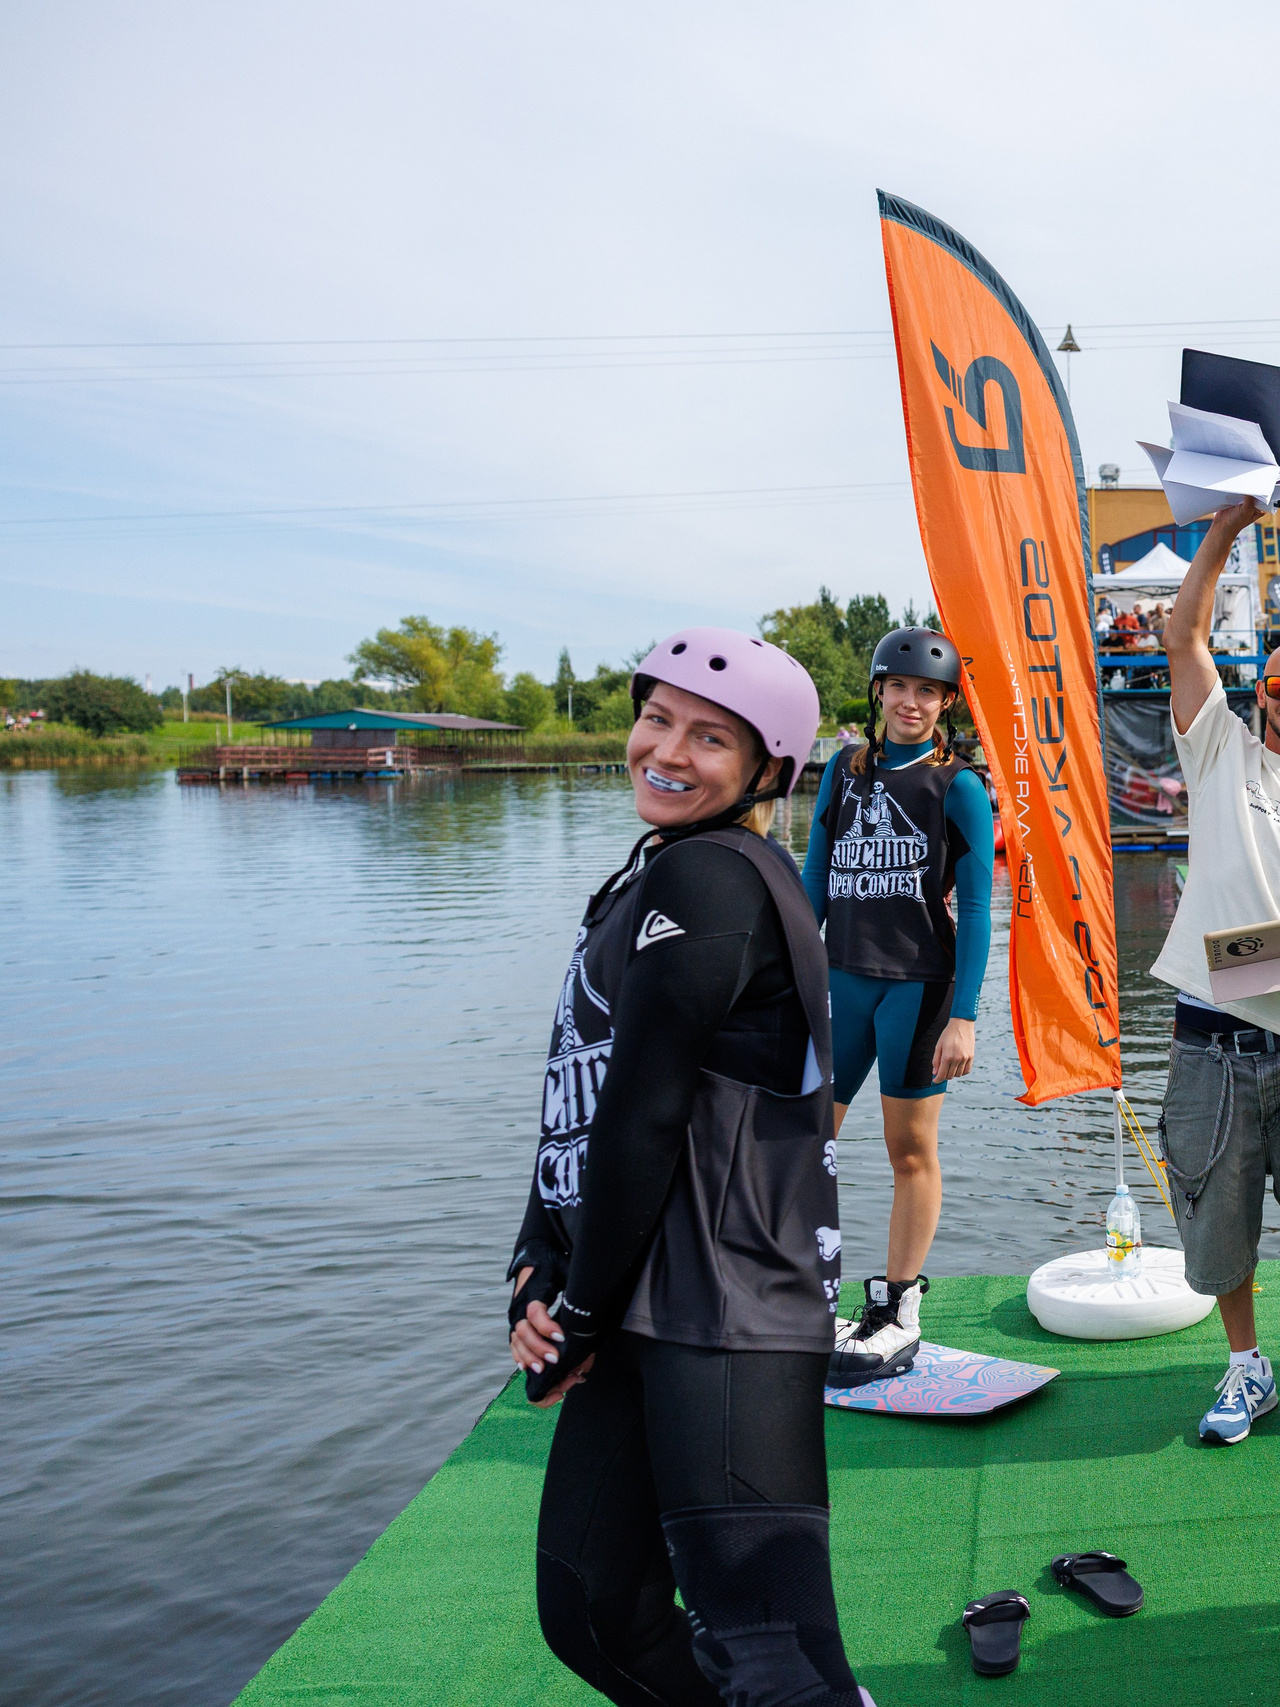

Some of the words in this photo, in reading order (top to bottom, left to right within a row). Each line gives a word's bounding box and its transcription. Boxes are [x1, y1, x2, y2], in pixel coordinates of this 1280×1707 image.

[1249, 802, 1271, 816] SUPPORT
[854, 869, 926, 901] CONTEST
[1212, 940, 1222, 963] DOUBLE
